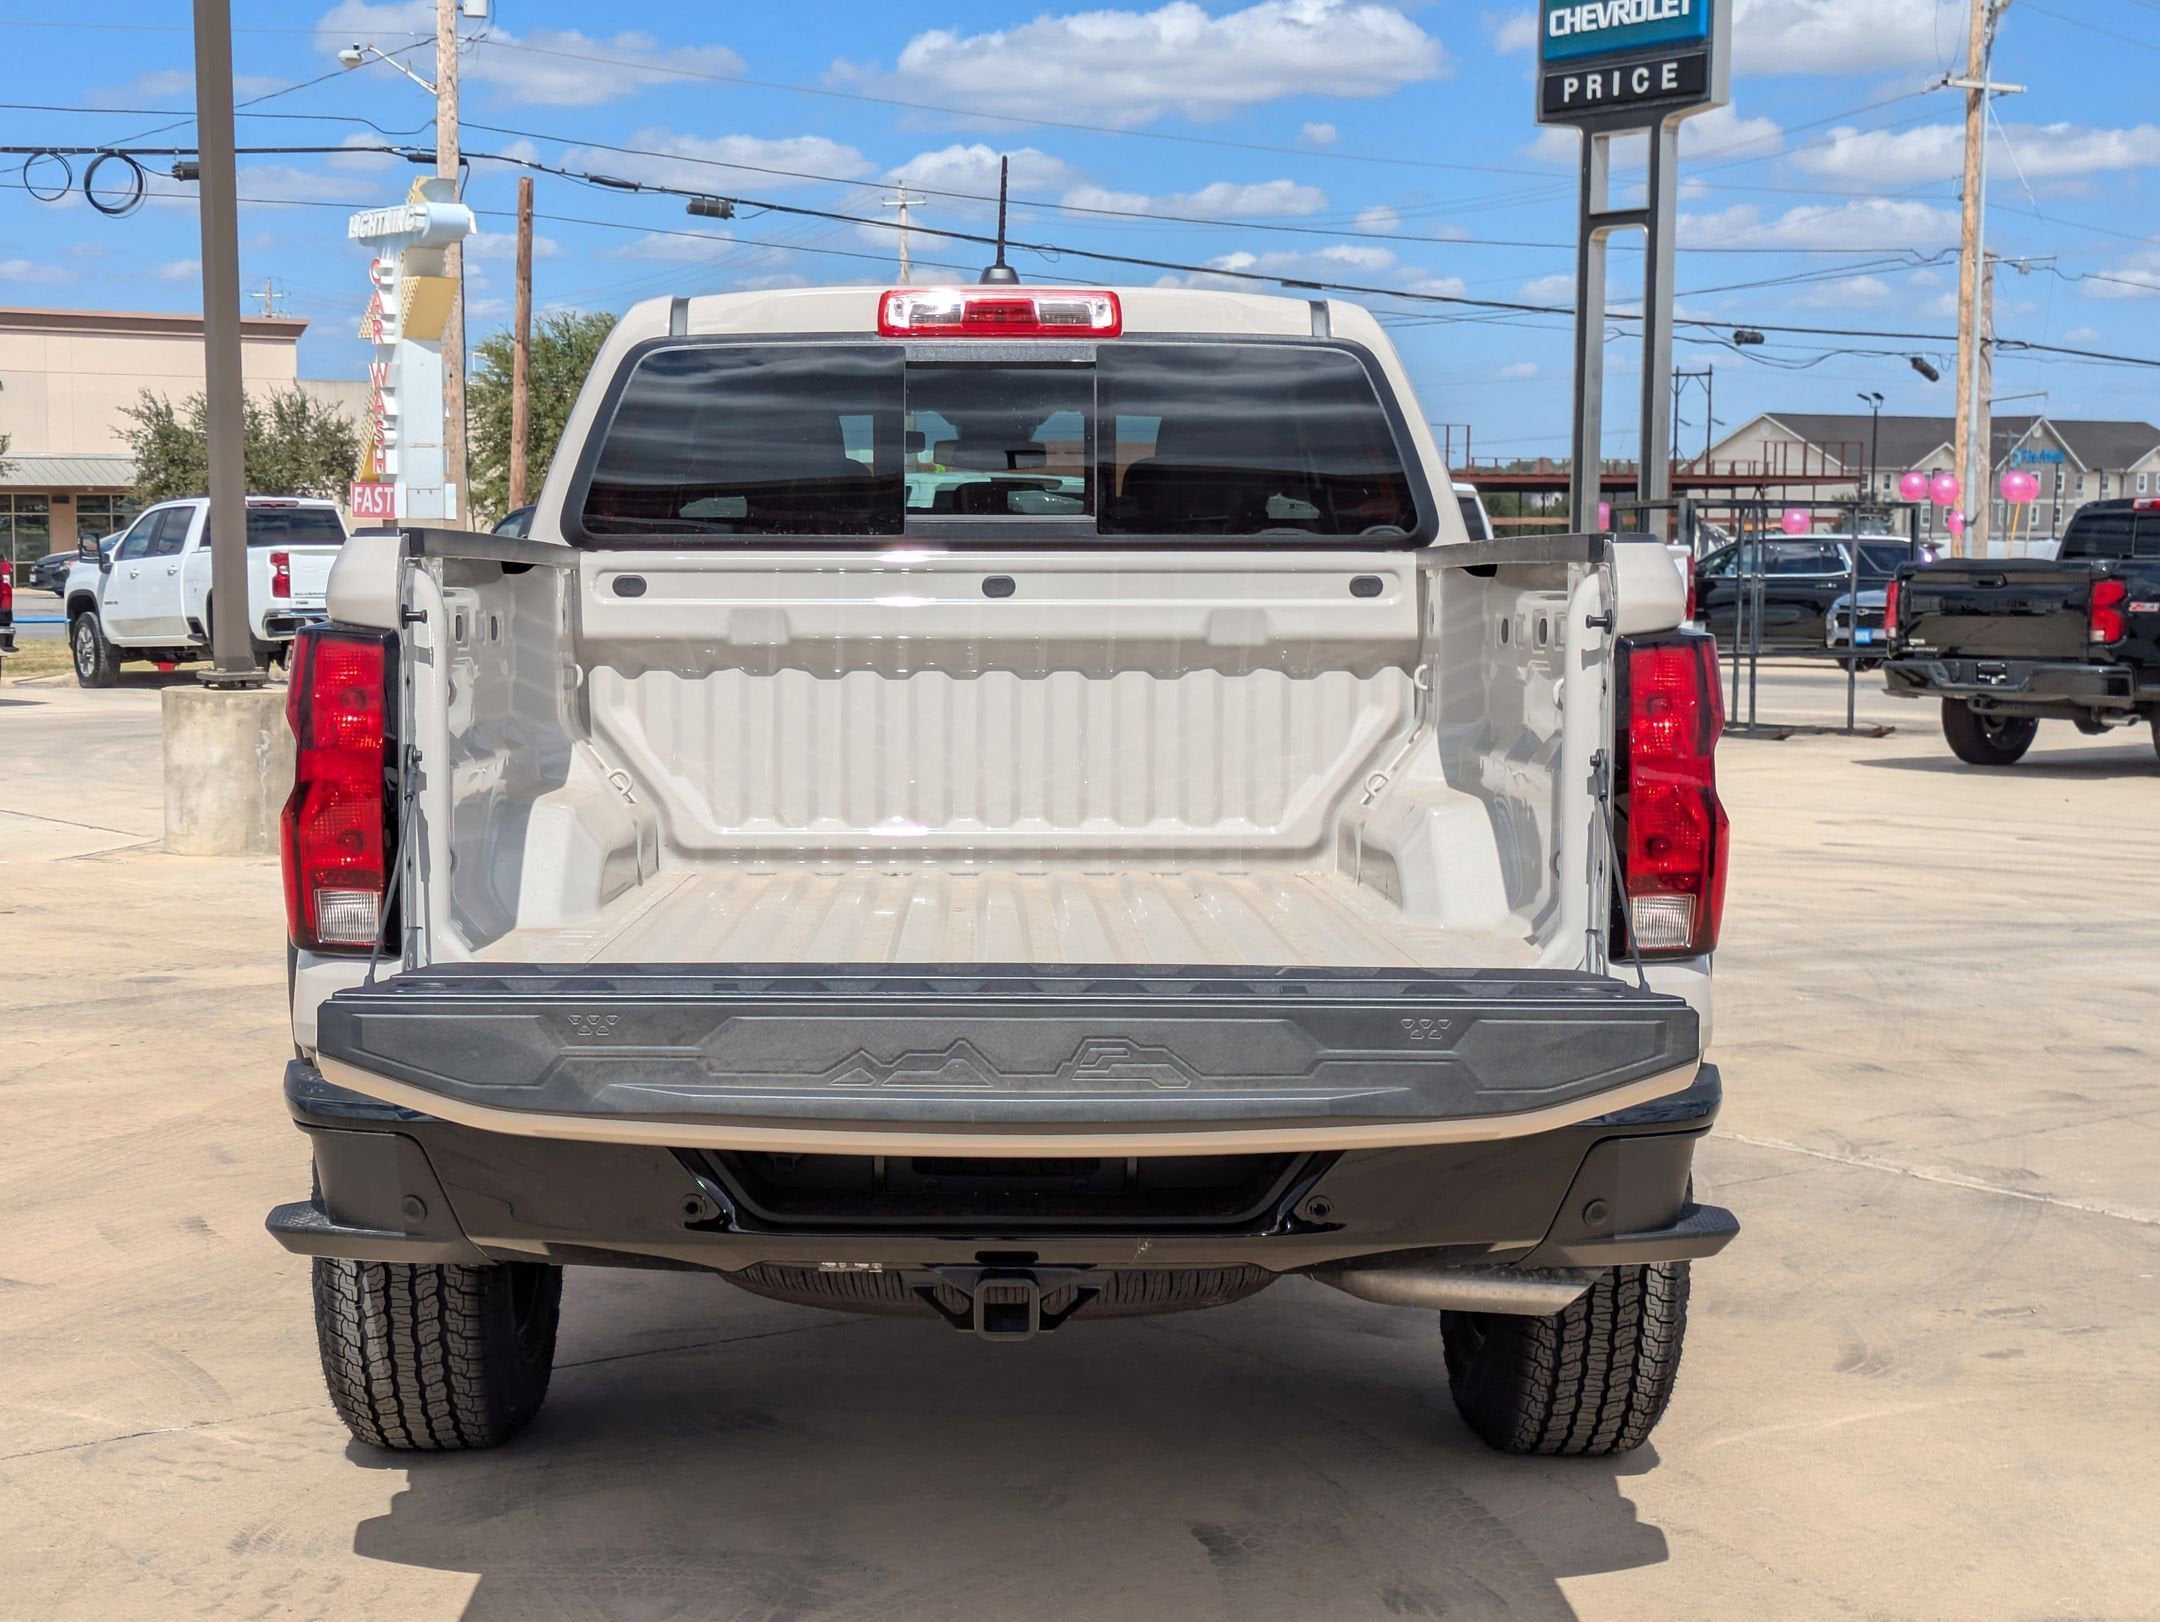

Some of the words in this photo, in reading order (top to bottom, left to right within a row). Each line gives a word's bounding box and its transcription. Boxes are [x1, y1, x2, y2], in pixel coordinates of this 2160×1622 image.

[1549, 0, 1691, 38] CHEVROLET
[1563, 62, 1679, 103] PRICE
[349, 208, 417, 239] LIGHTNING
[369, 257, 385, 345] CAR
[369, 363, 389, 474] WASH
[353, 486, 394, 513] FAST
